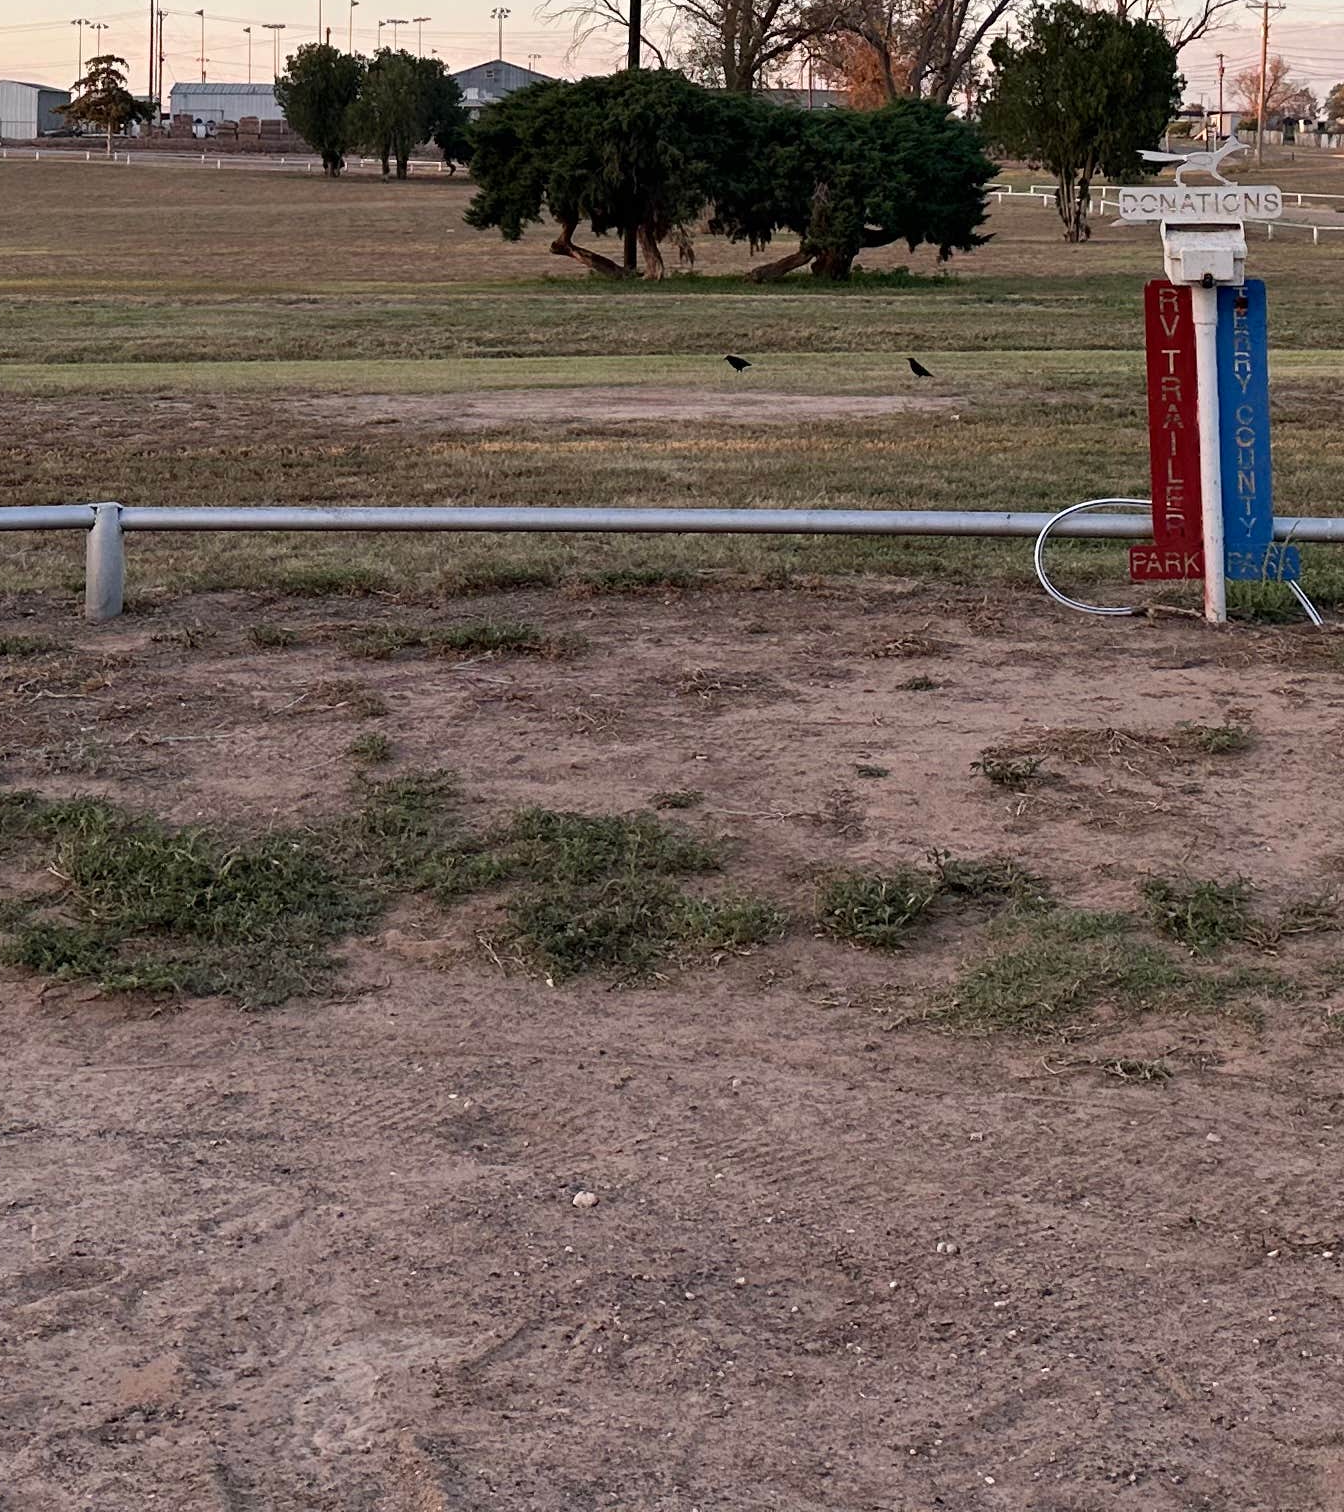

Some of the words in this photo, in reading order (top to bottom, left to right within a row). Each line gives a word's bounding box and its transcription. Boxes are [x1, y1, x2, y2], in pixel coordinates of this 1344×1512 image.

[1122, 193, 1279, 214] DONATIONS
[1158, 288, 1180, 338] RV
[1160, 349, 1185, 538] TRAILER
[1234, 404, 1258, 538] COUNTY
[1132, 551, 1201, 574] PARK
